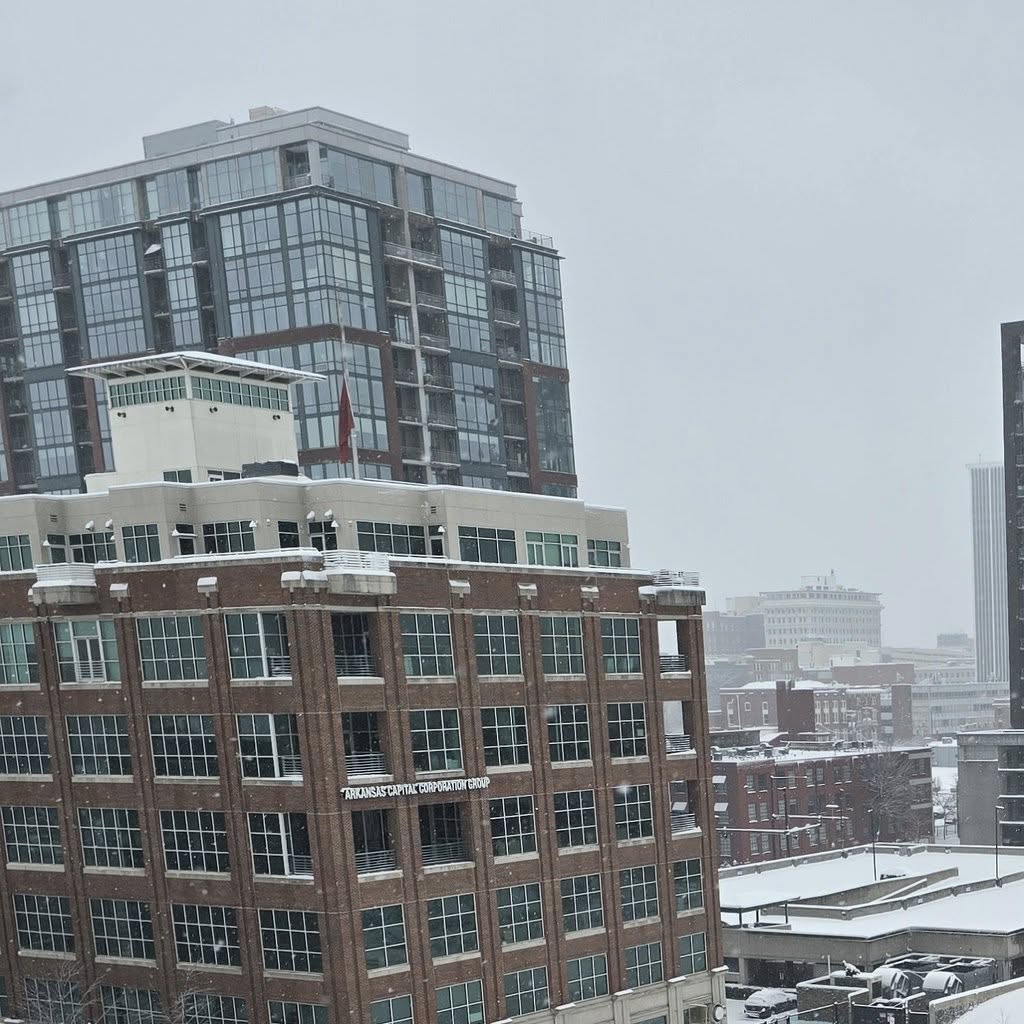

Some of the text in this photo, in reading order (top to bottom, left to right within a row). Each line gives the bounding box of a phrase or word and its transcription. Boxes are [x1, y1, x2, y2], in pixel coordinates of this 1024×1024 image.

[344, 777, 490, 800] ARKANSAS CAPITAL CORPORATION GROUP
